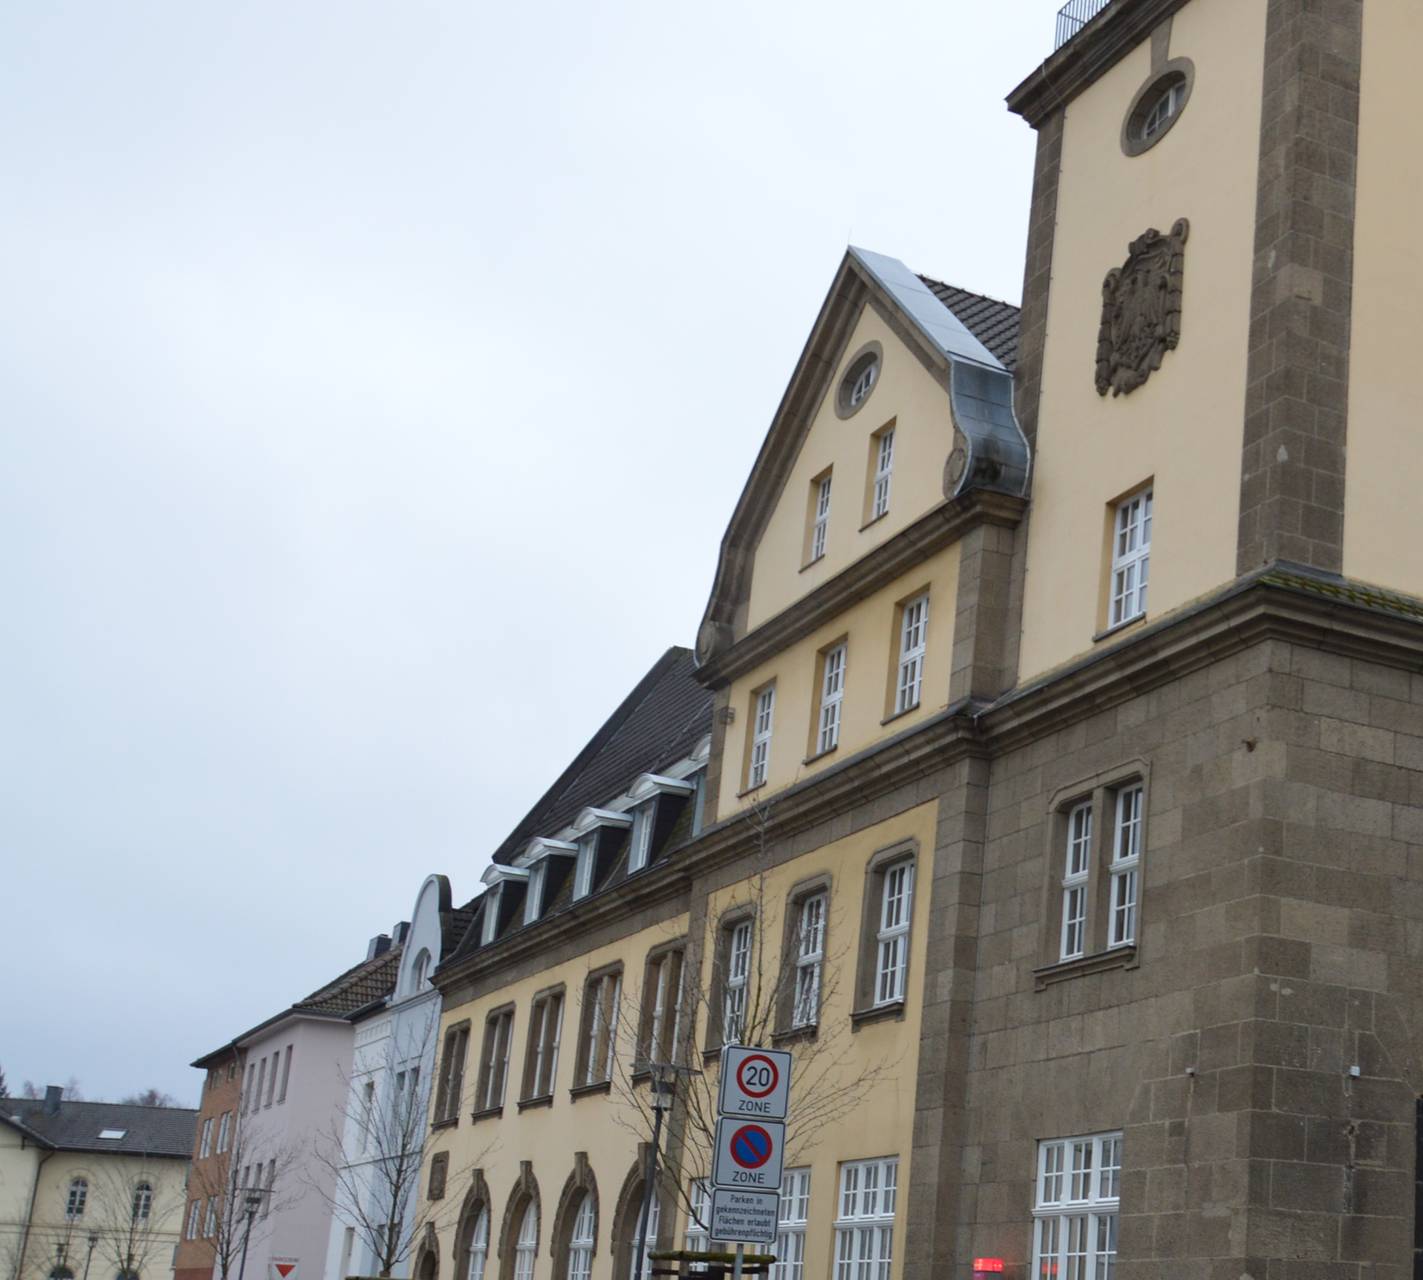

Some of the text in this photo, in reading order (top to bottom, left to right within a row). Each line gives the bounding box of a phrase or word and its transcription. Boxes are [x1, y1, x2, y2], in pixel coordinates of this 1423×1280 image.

[746, 1066, 770, 1087] 20
[738, 1100, 771, 1114] ZONE
[732, 1171, 765, 1184] ZONE
